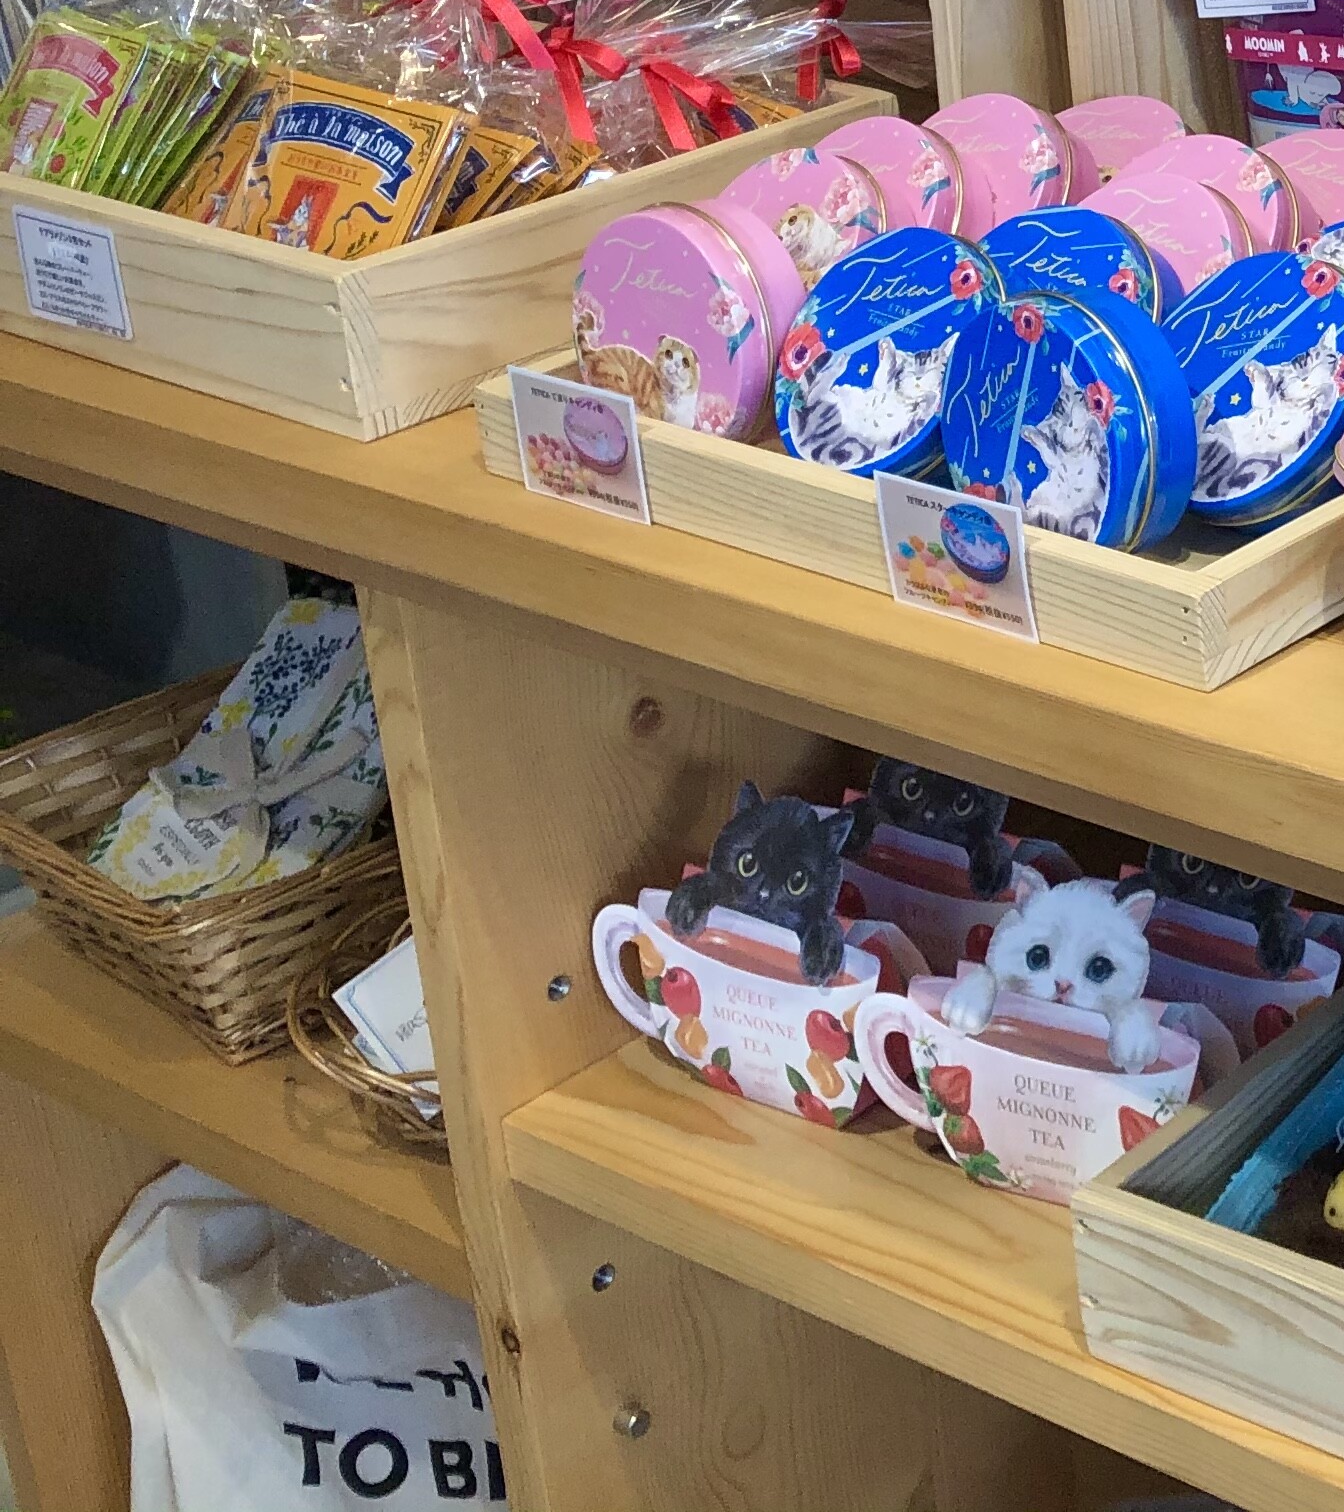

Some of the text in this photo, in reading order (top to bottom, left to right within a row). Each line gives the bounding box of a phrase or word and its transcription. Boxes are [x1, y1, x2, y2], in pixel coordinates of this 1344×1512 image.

[1244, 36, 1285, 53] MOOMIN
[346, 126, 404, 165] maison
[1005, 221, 1089, 288] Tetica
[836, 247, 947, 316] Tetica
[1171, 279, 1300, 369] Tetica
[1241, 328, 1270, 340] STAR
[726, 985, 777, 1011] QUEUE
[712, 1004, 797, 1041] MIGNONNE
[741, 1035, 772, 1057] TEA
[1015, 1073, 1076, 1103] QUEUE
[997, 1095, 1097, 1133] MIGNONNE
[1028, 1128, 1065, 1151] TEA
[283, 1423, 409, 1499] TO
